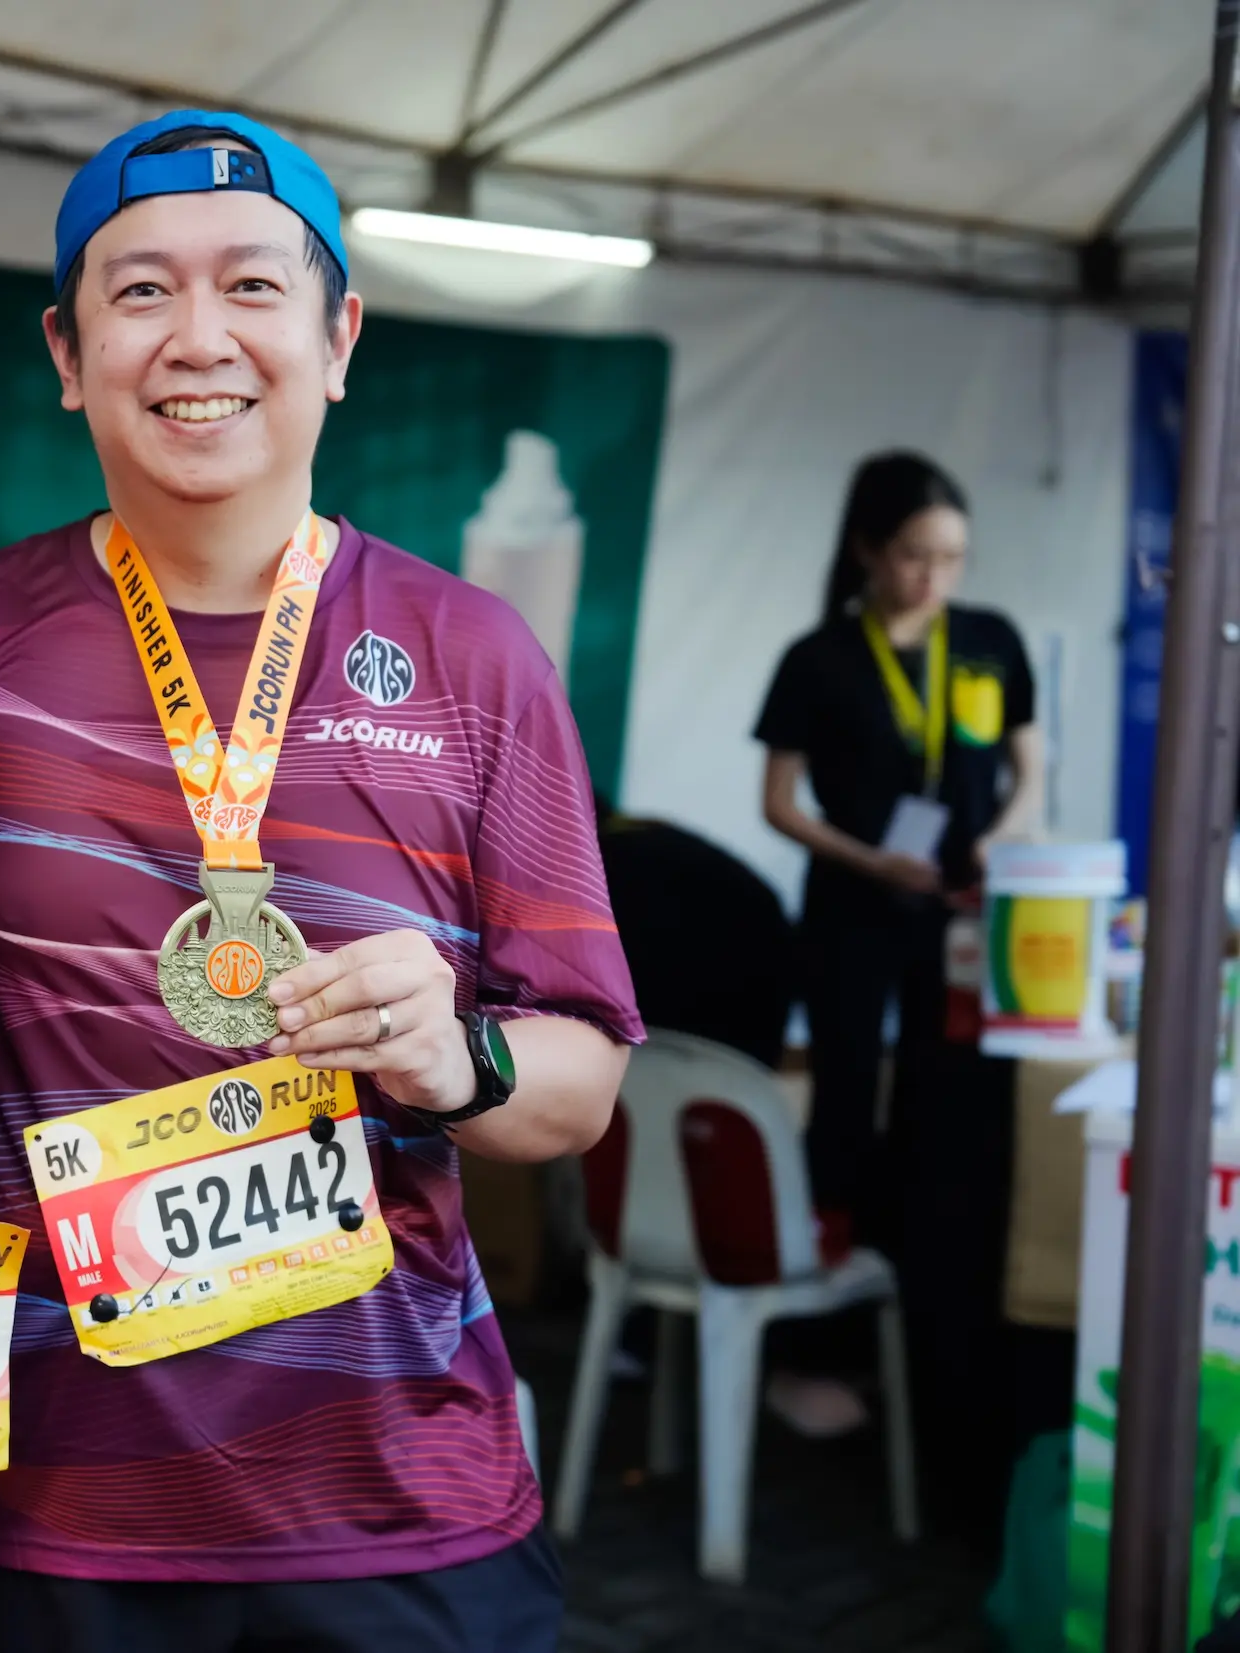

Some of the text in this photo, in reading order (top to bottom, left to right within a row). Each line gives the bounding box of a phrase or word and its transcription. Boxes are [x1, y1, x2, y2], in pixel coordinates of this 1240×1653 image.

[116, 547, 192, 719] FINISHER 5K
[248, 594, 305, 735] JCORUN PH
[305, 717, 445, 759] JCORUN
[126, 1070, 337, 1150] JCO RUN
[309, 1097, 337, 1120] 2025
[44, 1137, 88, 1182] 5K
[154, 1139, 356, 1259] 52442
[57, 1212, 103, 1272] M
[77, 1269, 103, 1288] MALE
